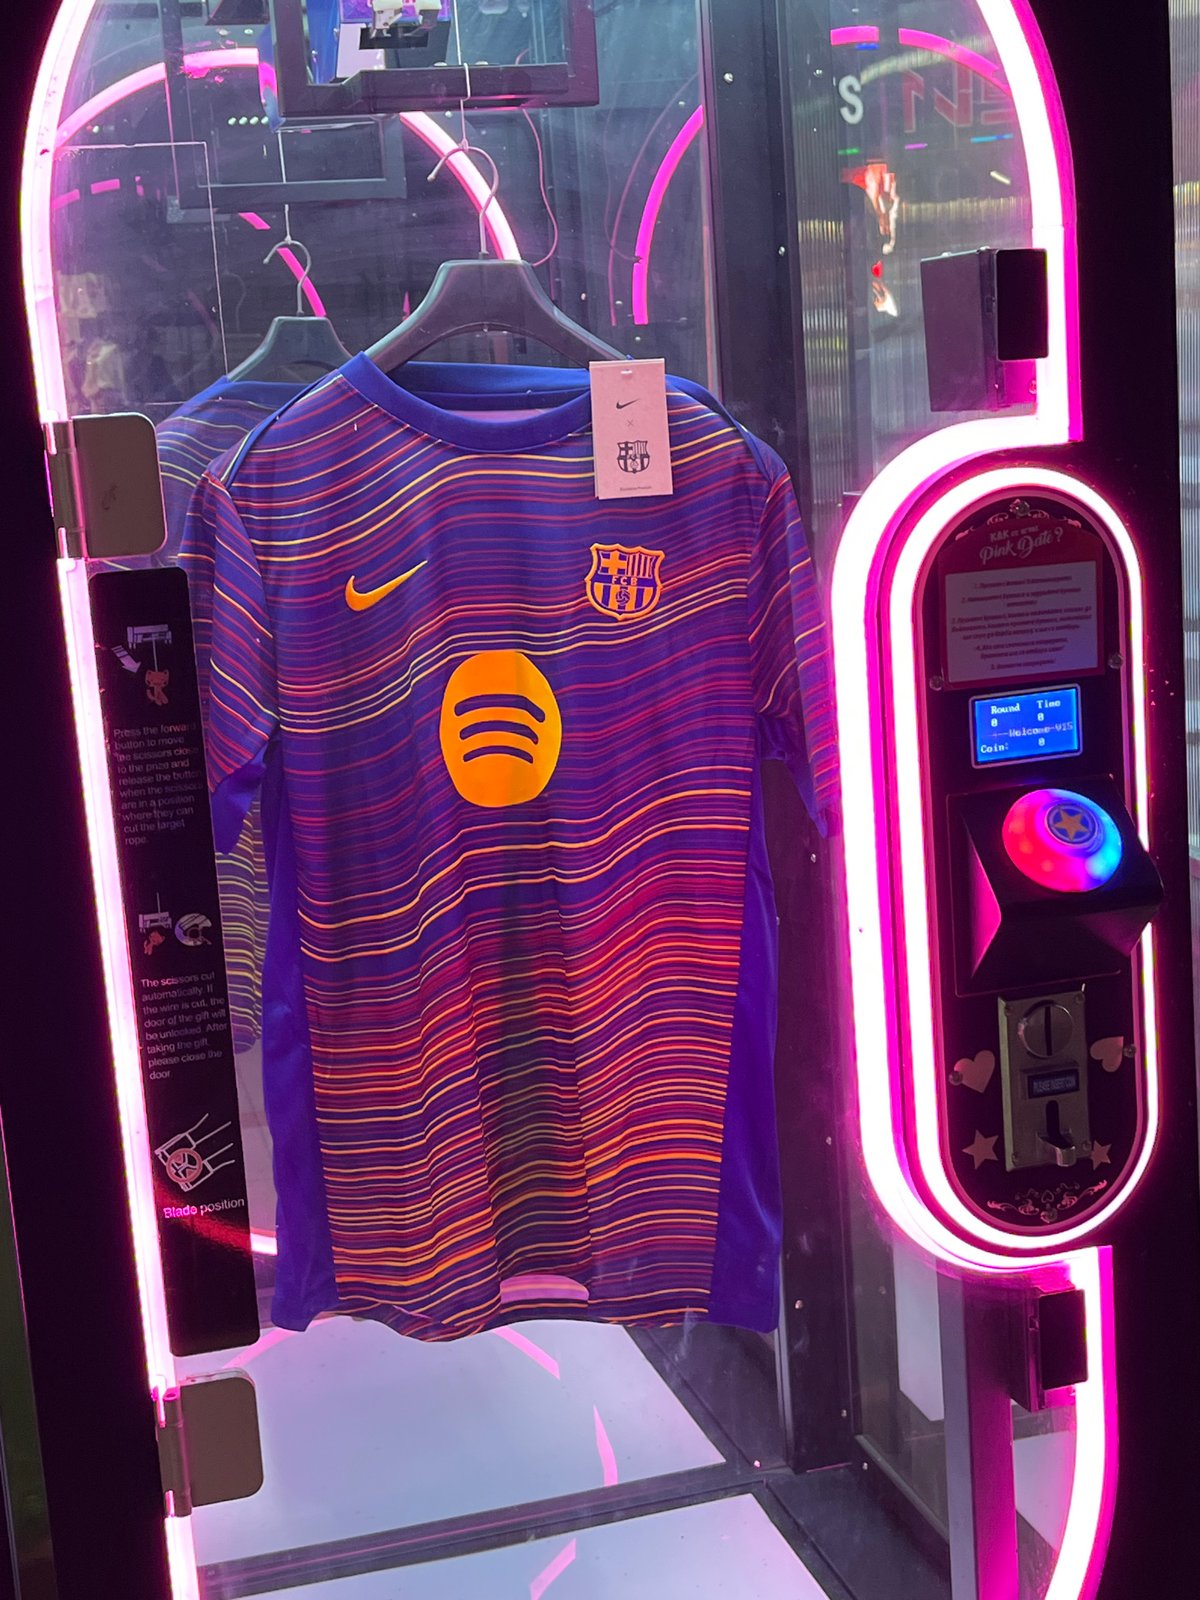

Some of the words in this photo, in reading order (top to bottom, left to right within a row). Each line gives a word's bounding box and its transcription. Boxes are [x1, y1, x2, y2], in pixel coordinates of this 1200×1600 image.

[979, 540, 1017, 565] Pink
[612, 576, 637, 586] FCB
[990, 702, 1021, 715] Round
[1036, 699, 1062, 710] Time
[113, 728, 141, 738] Press
[143, 726, 158, 735] the
[115, 739, 145, 750] button
[147, 738, 156, 747] to
[158, 736, 185, 745] move
[980, 742, 1009, 754] Coin:
[133, 750, 173, 760] scissors
[117, 765, 127, 774] to
[128, 764, 143, 773] the
[146, 763, 169, 773] prize
[171, 758, 190, 769] and
[118, 775, 154, 786] release
[155, 773, 171, 782] the
[172, 770, 202, 780] button
[119, 788, 146, 798] when
[147, 786, 163, 795] the
[164, 783, 203, 793] scissors
[121, 801, 137, 810] are
[139, 799, 148, 808] in
[149, 799, 157, 808] a
[158, 794, 195, 807] position
[122, 810, 153, 822] where
[153, 808, 174, 819] they
[175, 806, 194, 816] can
[124, 824, 139, 834] cut
[140, 822, 155, 832] the
[157, 818, 185, 831] target
[141, 978, 160, 988] The
[161, 974, 199, 986] scissors
[200, 970, 215, 980] cut
[143, 1005, 158, 1015] the
[159, 1003, 179, 1012] wire
[181, 1002, 190, 1010] is
[210, 997, 225, 1006] the
[144, 1018, 166, 1028] door
[167, 1015, 177, 1025] of
[178, 1014, 193, 1023] the
[195, 1010, 209, 1023] gift
[211, 1008, 226, 1018] will
[145, 1031, 159, 1041] be
[206, 1022, 227, 1033] After
[146, 1043, 175, 1055] taking
[176, 1041, 193, 1050] the
[148, 1056, 180, 1069] please
[181, 1052, 206, 1063] close
[207, 1049, 223, 1058] the
[163, 1204, 198, 1219] Blade
[200, 1198, 245, 1216] position
